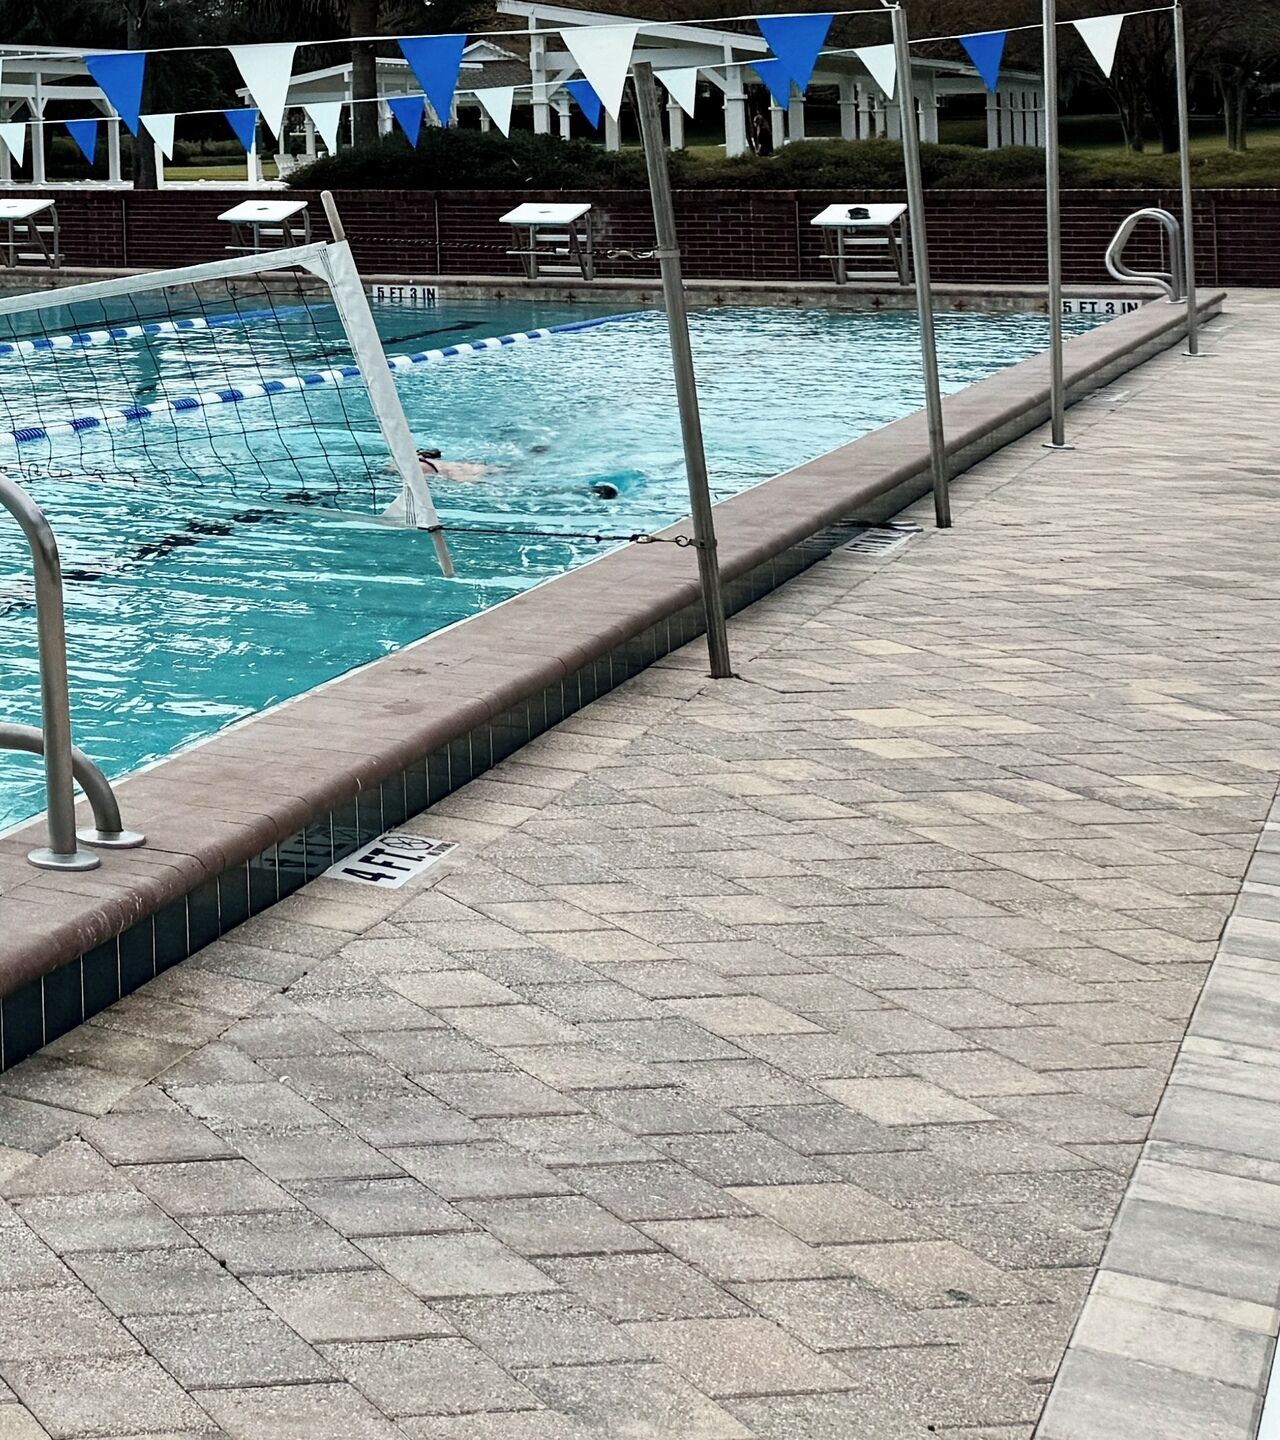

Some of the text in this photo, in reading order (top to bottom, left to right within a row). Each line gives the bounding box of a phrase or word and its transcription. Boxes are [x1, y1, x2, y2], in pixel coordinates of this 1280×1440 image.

[377, 287, 435, 299] 5 FT 3 IN
[1063, 301, 1138, 314] 5 FT 3 IN
[358, 847, 426, 871] FT.
[341, 867, 397, 881] 4
